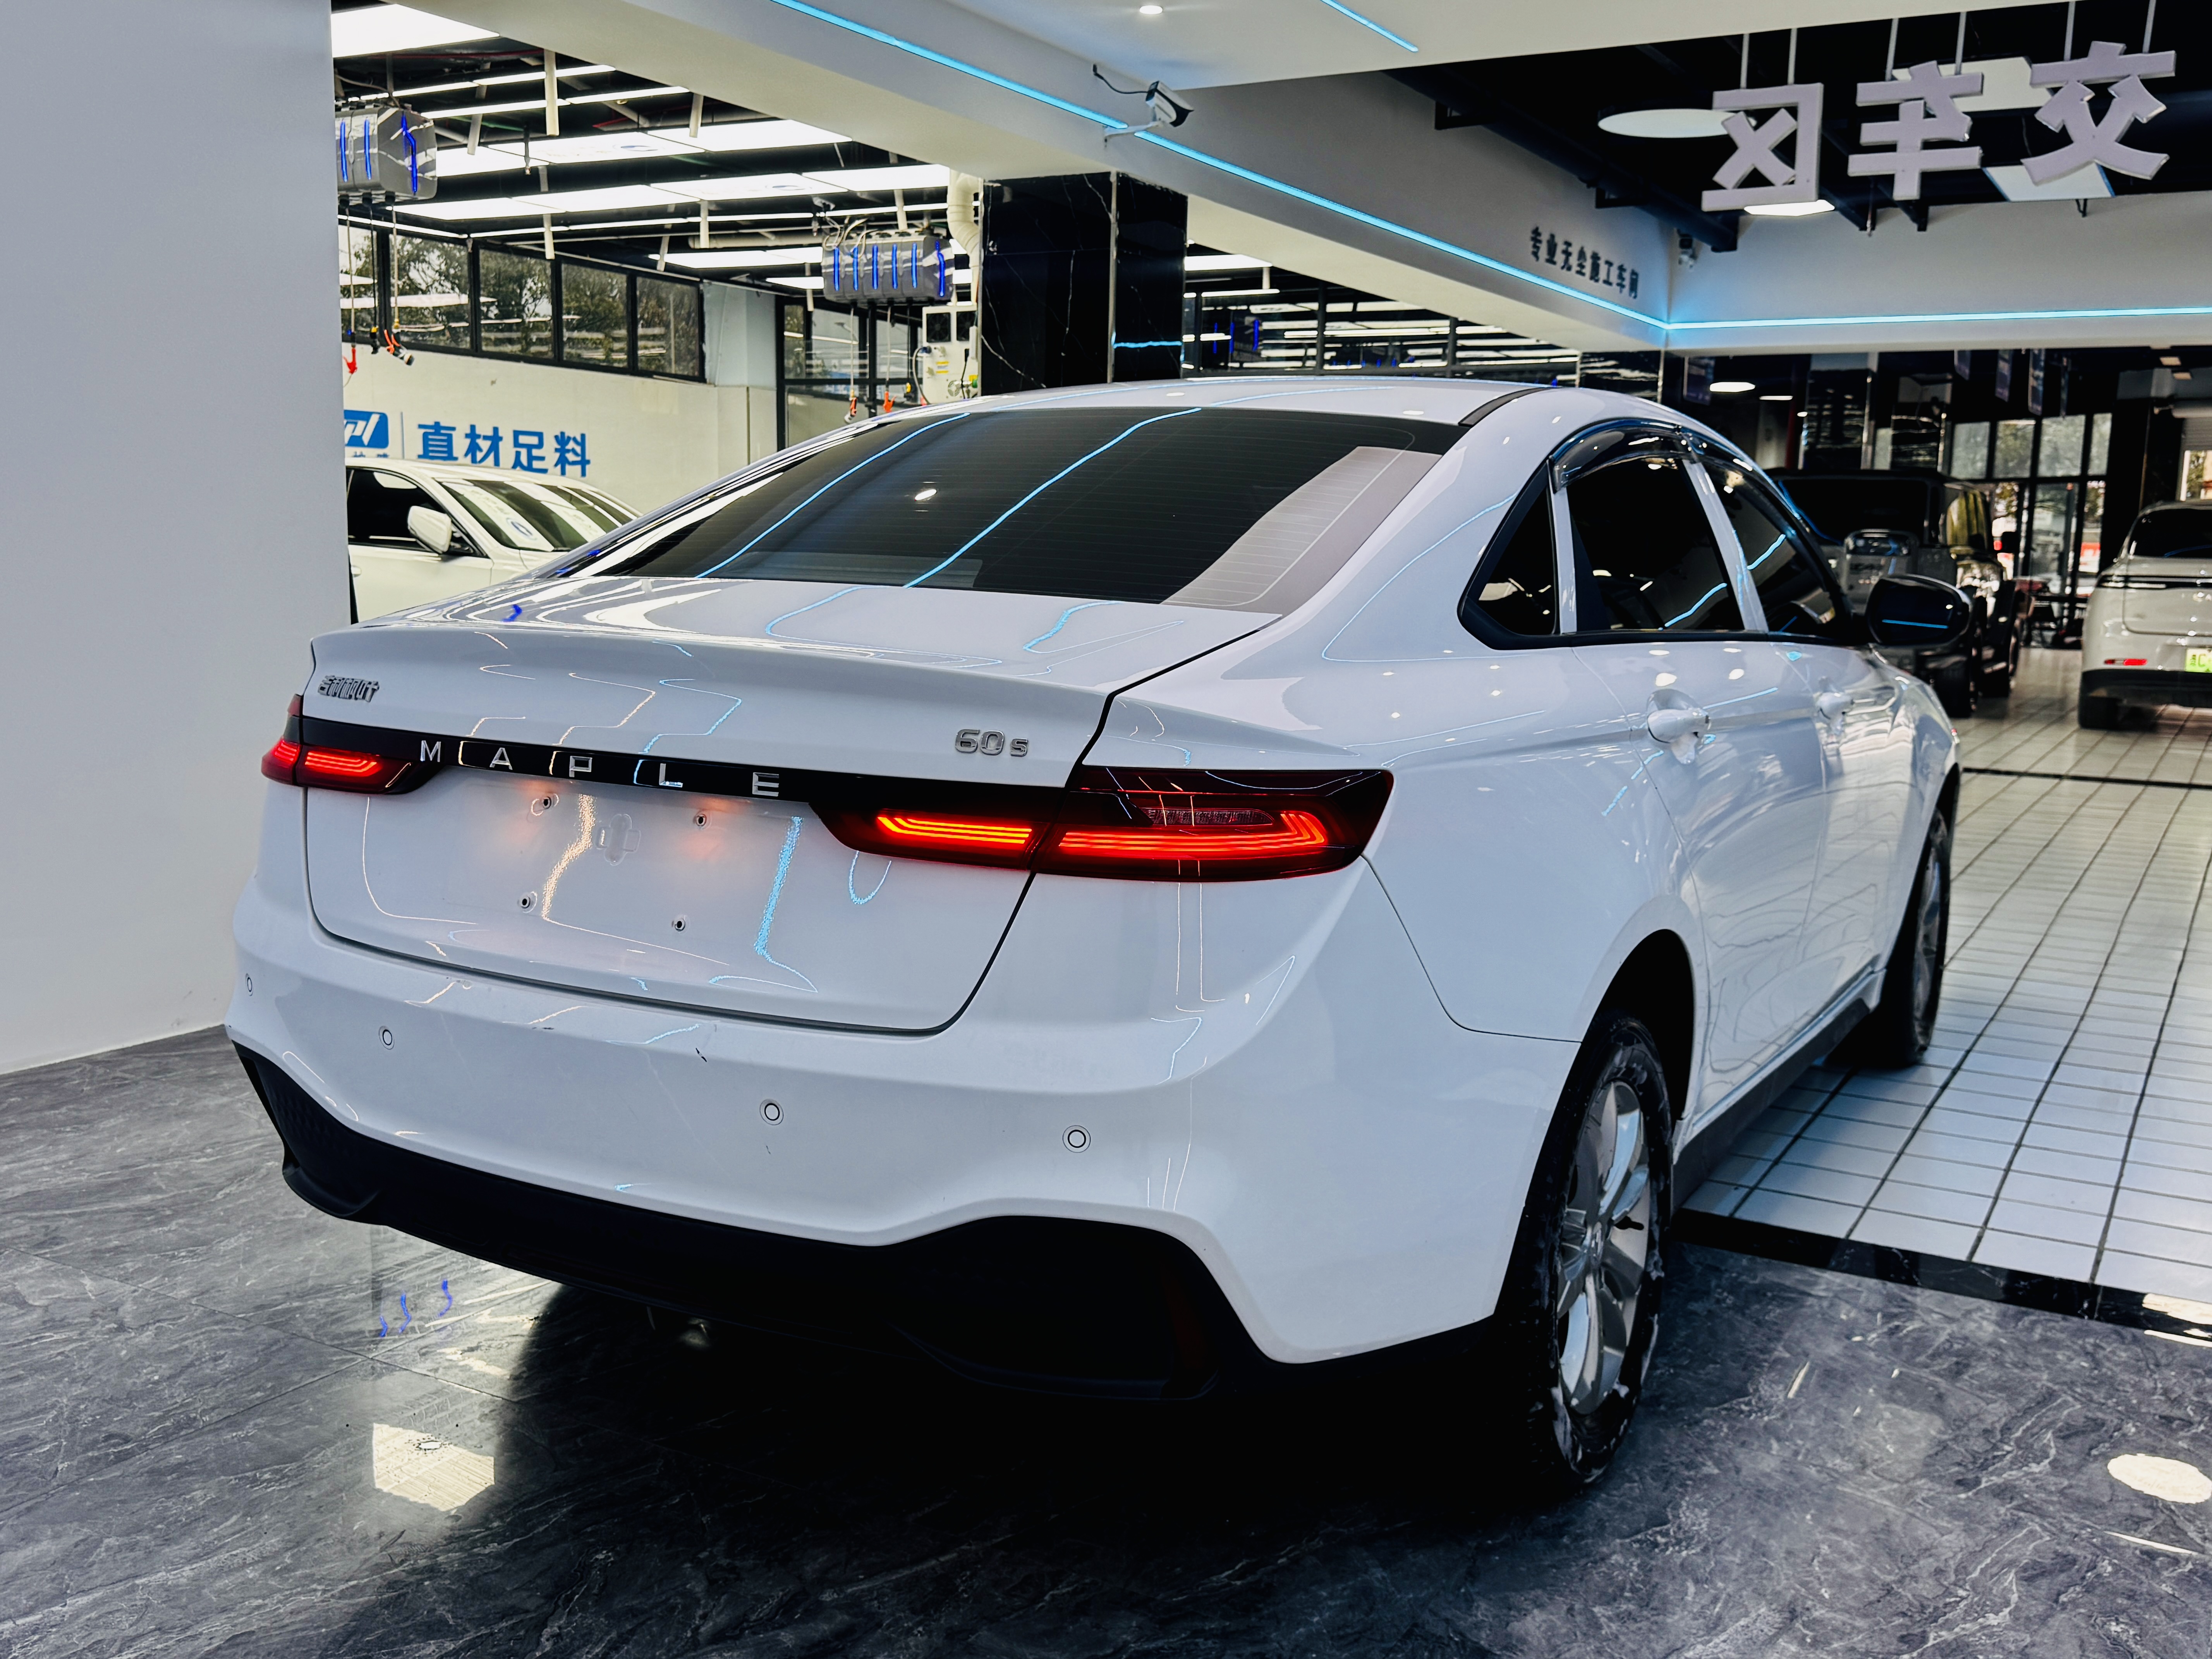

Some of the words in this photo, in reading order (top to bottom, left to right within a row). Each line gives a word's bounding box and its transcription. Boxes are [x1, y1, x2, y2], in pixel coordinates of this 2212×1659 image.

[417, 421, 591, 477] 直材足料
[420, 740, 780, 797] MAPLE
